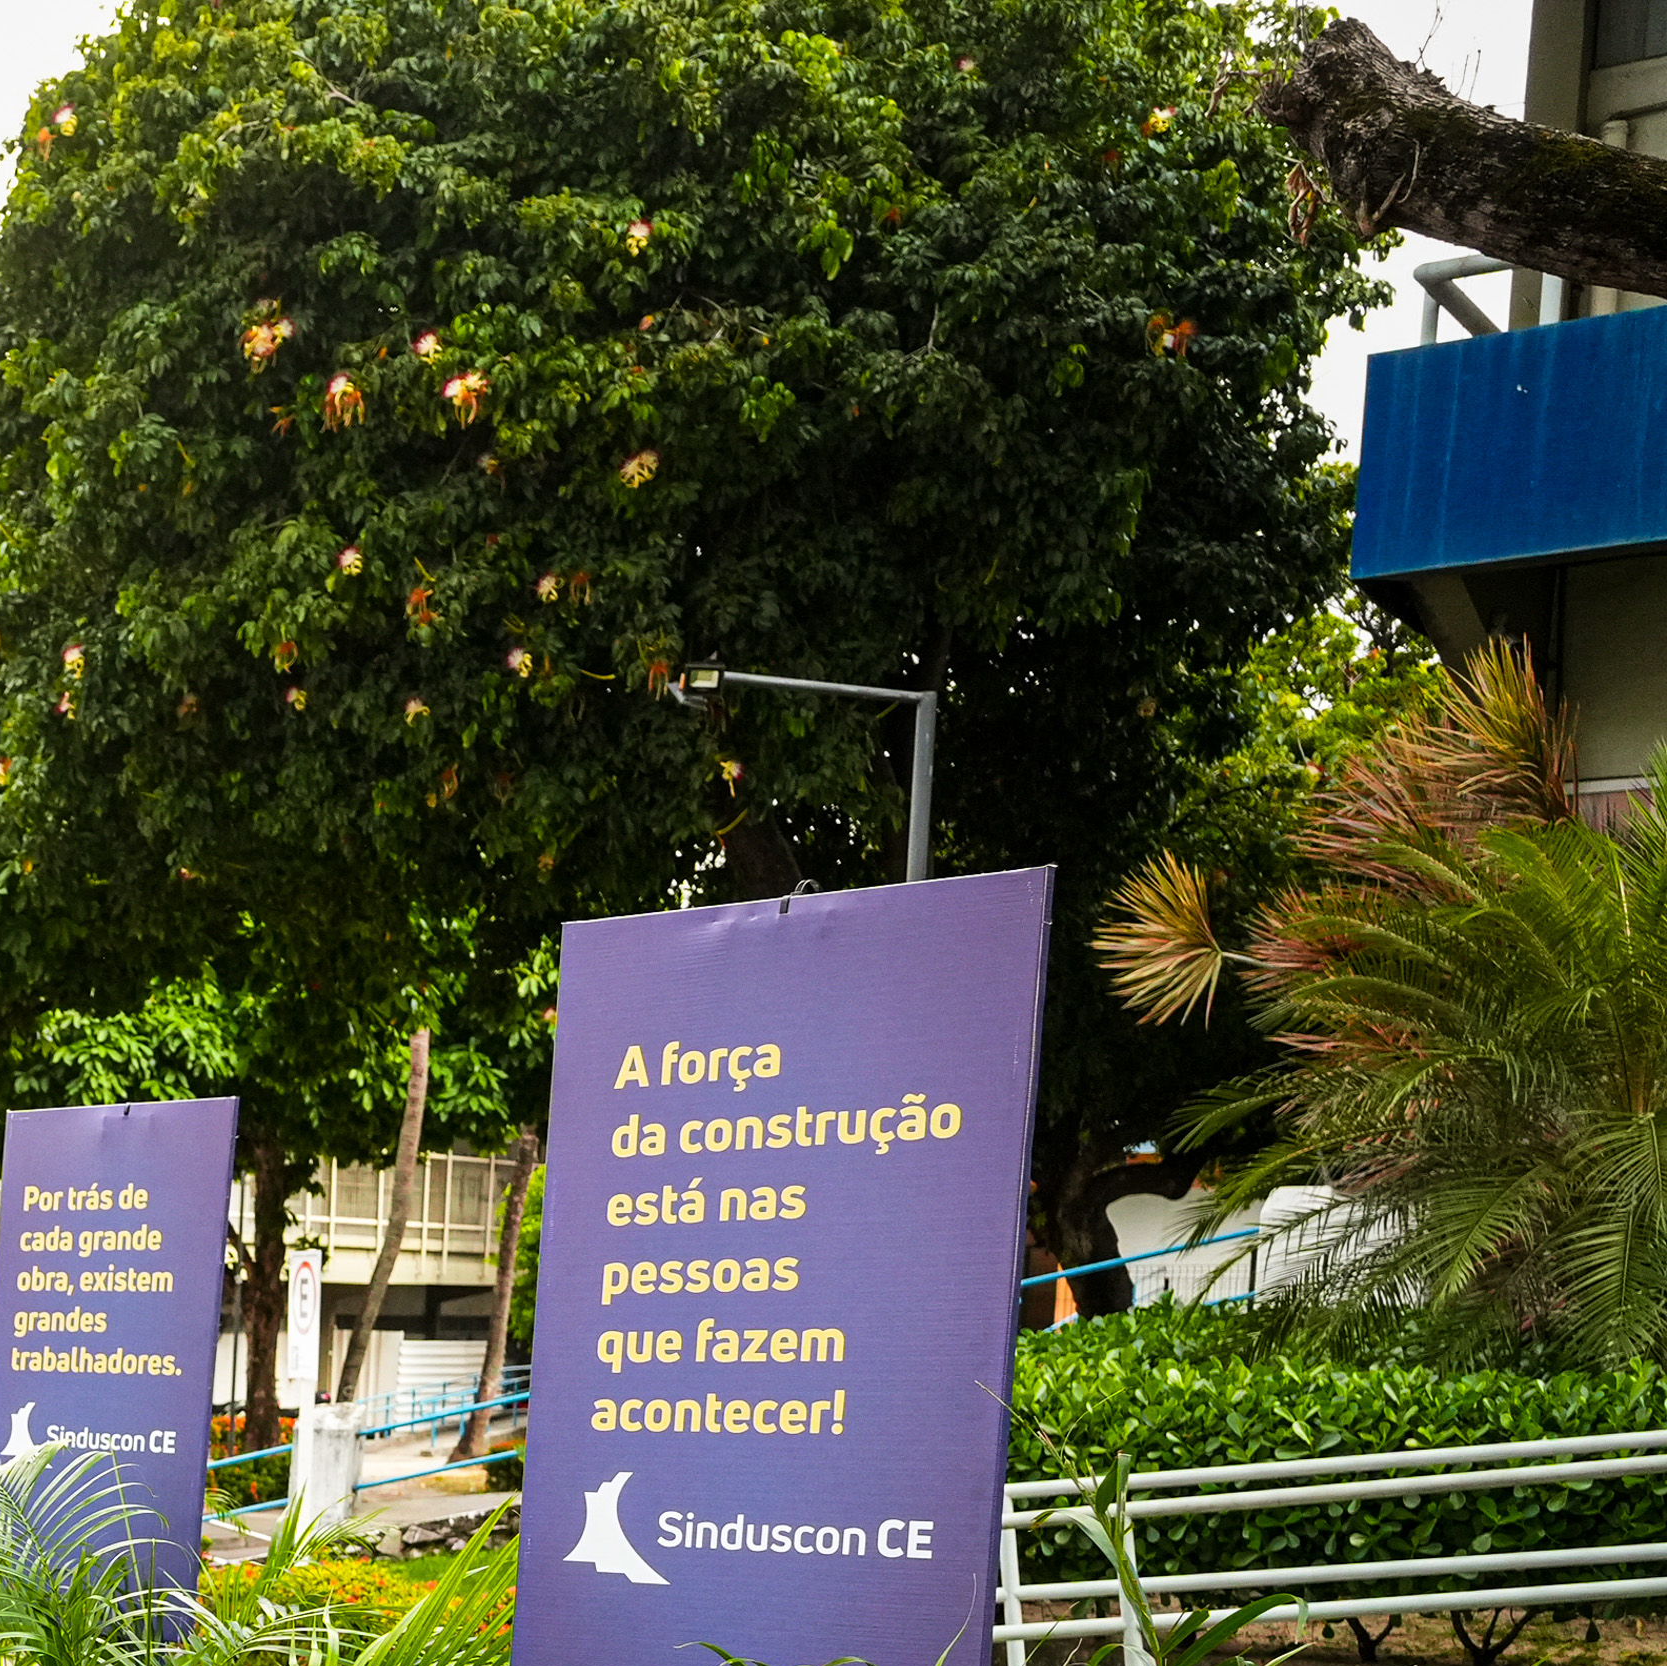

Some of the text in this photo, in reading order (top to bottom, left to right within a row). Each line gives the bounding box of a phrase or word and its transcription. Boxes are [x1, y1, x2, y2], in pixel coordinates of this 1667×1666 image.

[613, 1040, 781, 1092] A força
[611, 1093, 961, 1158] da construção
[23, 1182, 149, 1212] Por trás de
[606, 1177, 806, 1227] está nas
[19, 1223, 162, 1258] cada grande
[16, 1263, 174, 1297] obra, existem
[300, 1278, 309, 1318] E
[601, 1256, 799, 1306] pessoas
[13, 1305, 108, 1338] grandes
[11, 1345, 182, 1377] trabalhadores.
[596, 1317, 845, 1374] que fazem
[590, 1389, 846, 1435] acontecer!
[47, 1424, 177, 1454] Sinduscon CE
[656, 1510, 934, 1559] Sinduscon CE
